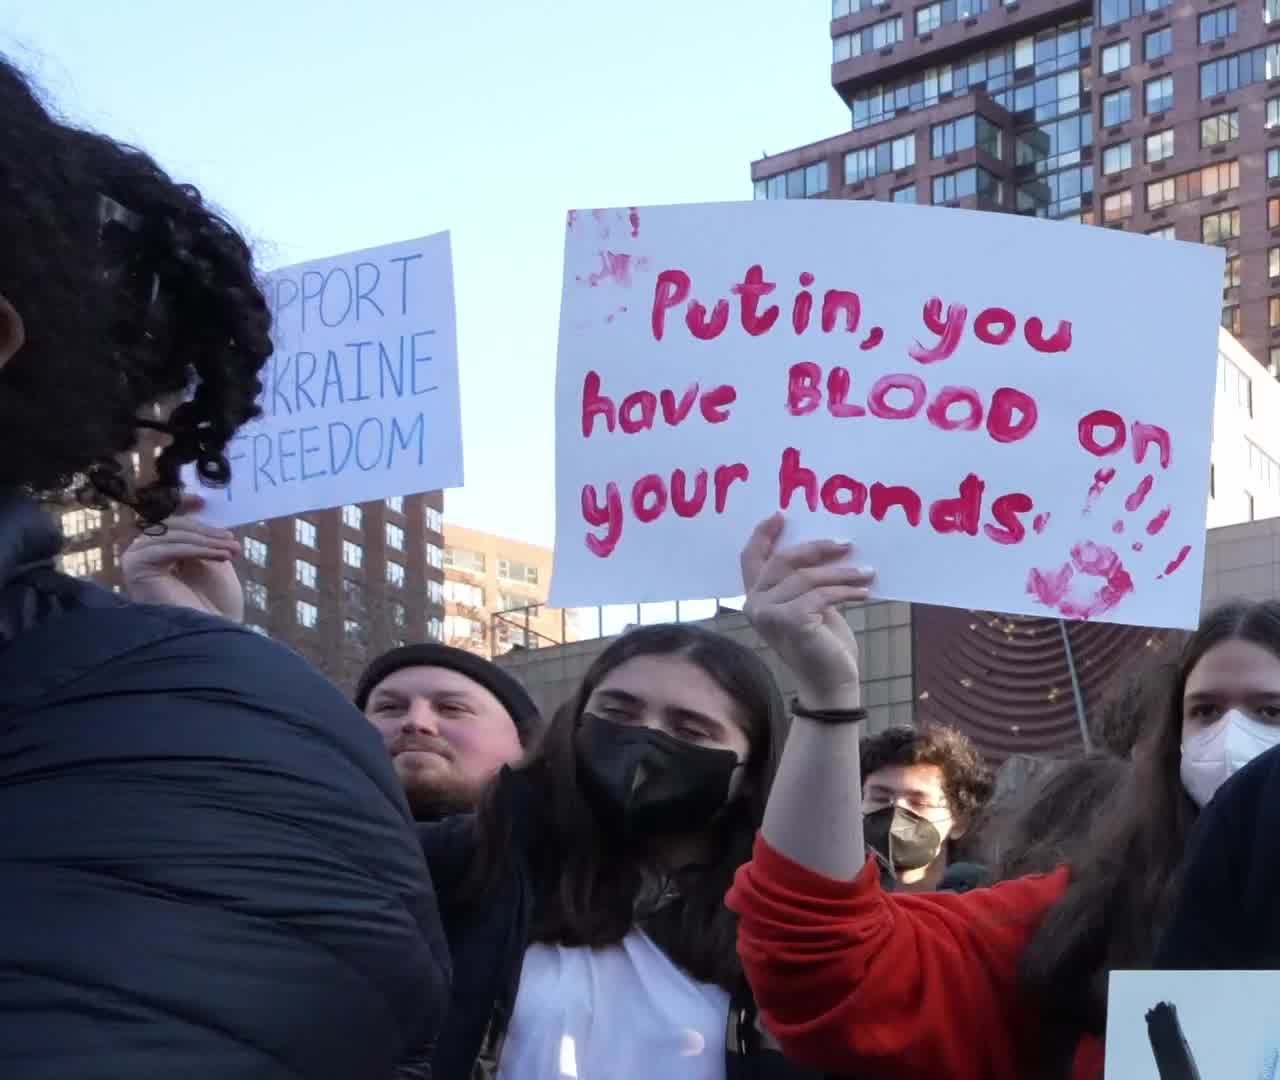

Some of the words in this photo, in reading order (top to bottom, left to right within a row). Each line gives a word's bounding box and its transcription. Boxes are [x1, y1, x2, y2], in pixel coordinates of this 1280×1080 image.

[273, 254, 423, 336] PPORT
[651, 263, 885, 351] Putin,
[907, 295, 1073, 364] you
[262, 330, 439, 416] KRAINE
[581, 369, 737, 438] have
[785, 360, 1039, 444] BLOOD
[222, 412, 425, 502] FREEDOM
[580, 462, 749, 559] your
